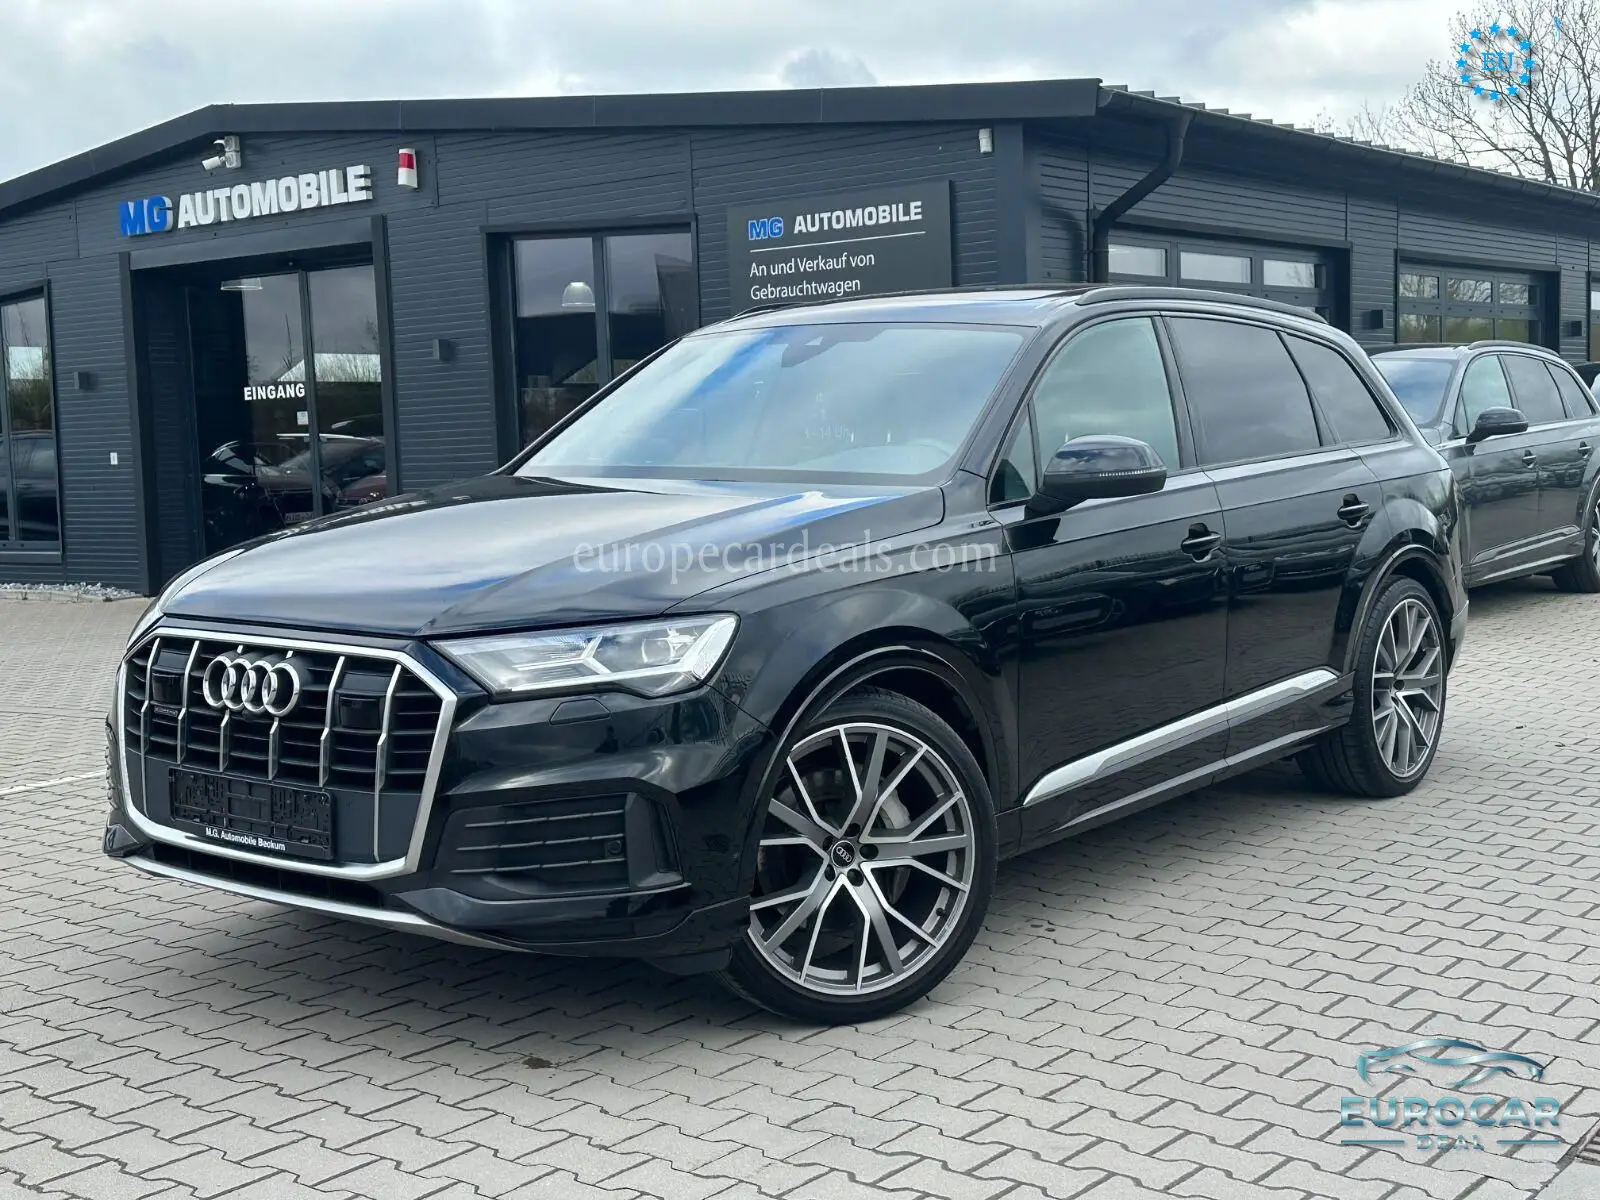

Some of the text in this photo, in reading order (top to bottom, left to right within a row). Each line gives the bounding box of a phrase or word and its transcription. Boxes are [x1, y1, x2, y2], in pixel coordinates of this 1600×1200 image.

[119, 164, 373, 236] MG AUTOMOBILE
[748, 201, 922, 240] MG AUTOMOBILE
[750, 252, 875, 277] An und Verkauf von
[750, 279, 861, 300] Gebrauchtwagen
[244, 383, 306, 400] EINGANG
[221, 831, 257, 846] Automobile
